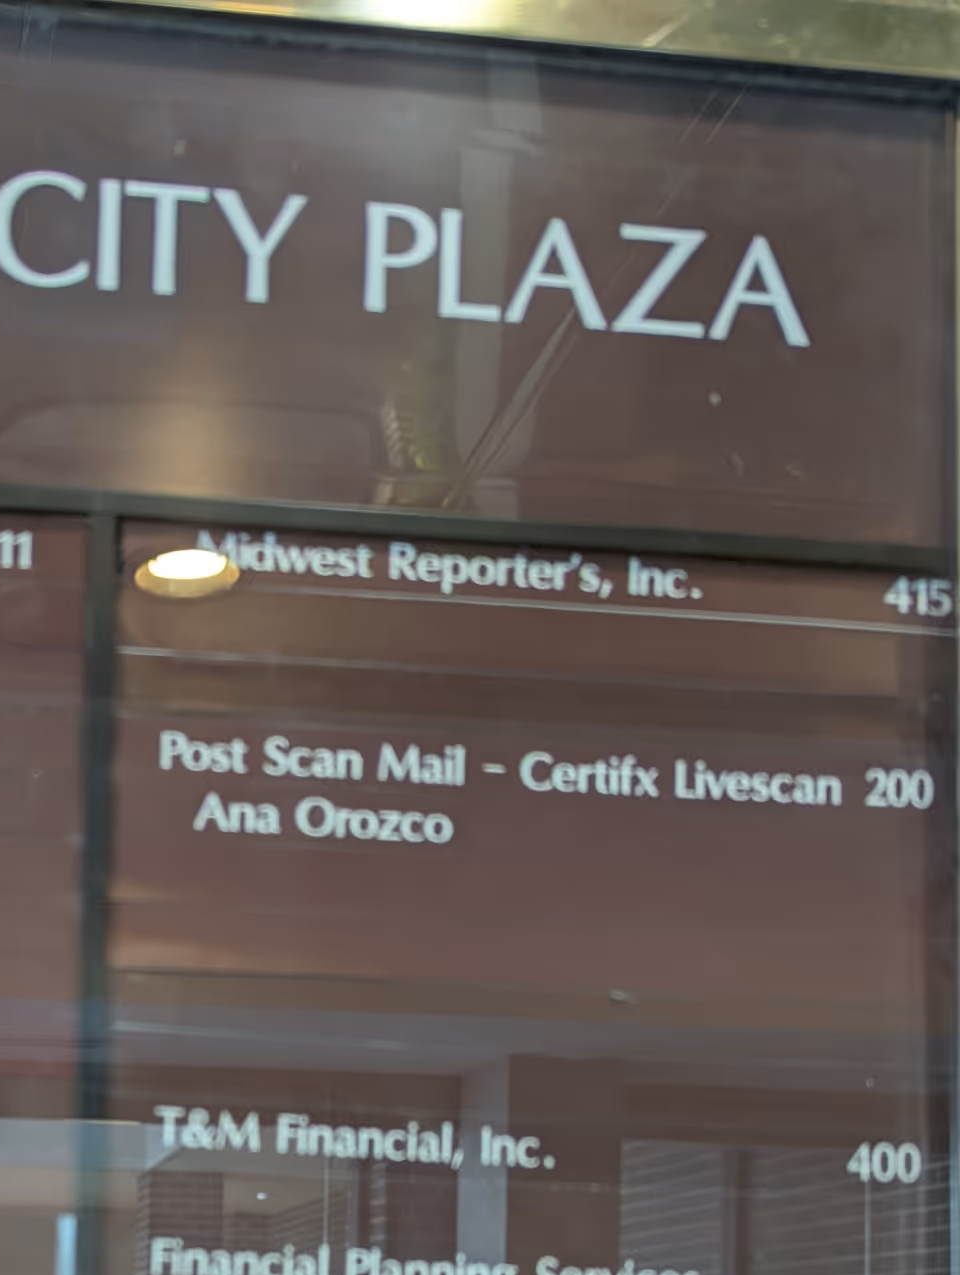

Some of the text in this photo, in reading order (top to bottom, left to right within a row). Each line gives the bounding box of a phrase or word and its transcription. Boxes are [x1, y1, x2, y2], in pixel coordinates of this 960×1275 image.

[362, 198, 812, 349] PLAZA
[196, 529, 374, 578] Midwest
[627, 555, 702, 601] Inc.
[883, 575, 952, 617] 415
[159, 731, 247, 774] Post
[263, 735, 362, 781] Scan
[378, 743, 466, 788] Mail
[520, 751, 659, 799] Certifx
[675, 759, 842, 807] Livescan
[865, 768, 935, 809] 200
[193, 792, 453, 844] Ana Orozco
[154, 1106, 921, 1183] T&M Financial, Inc. 400
